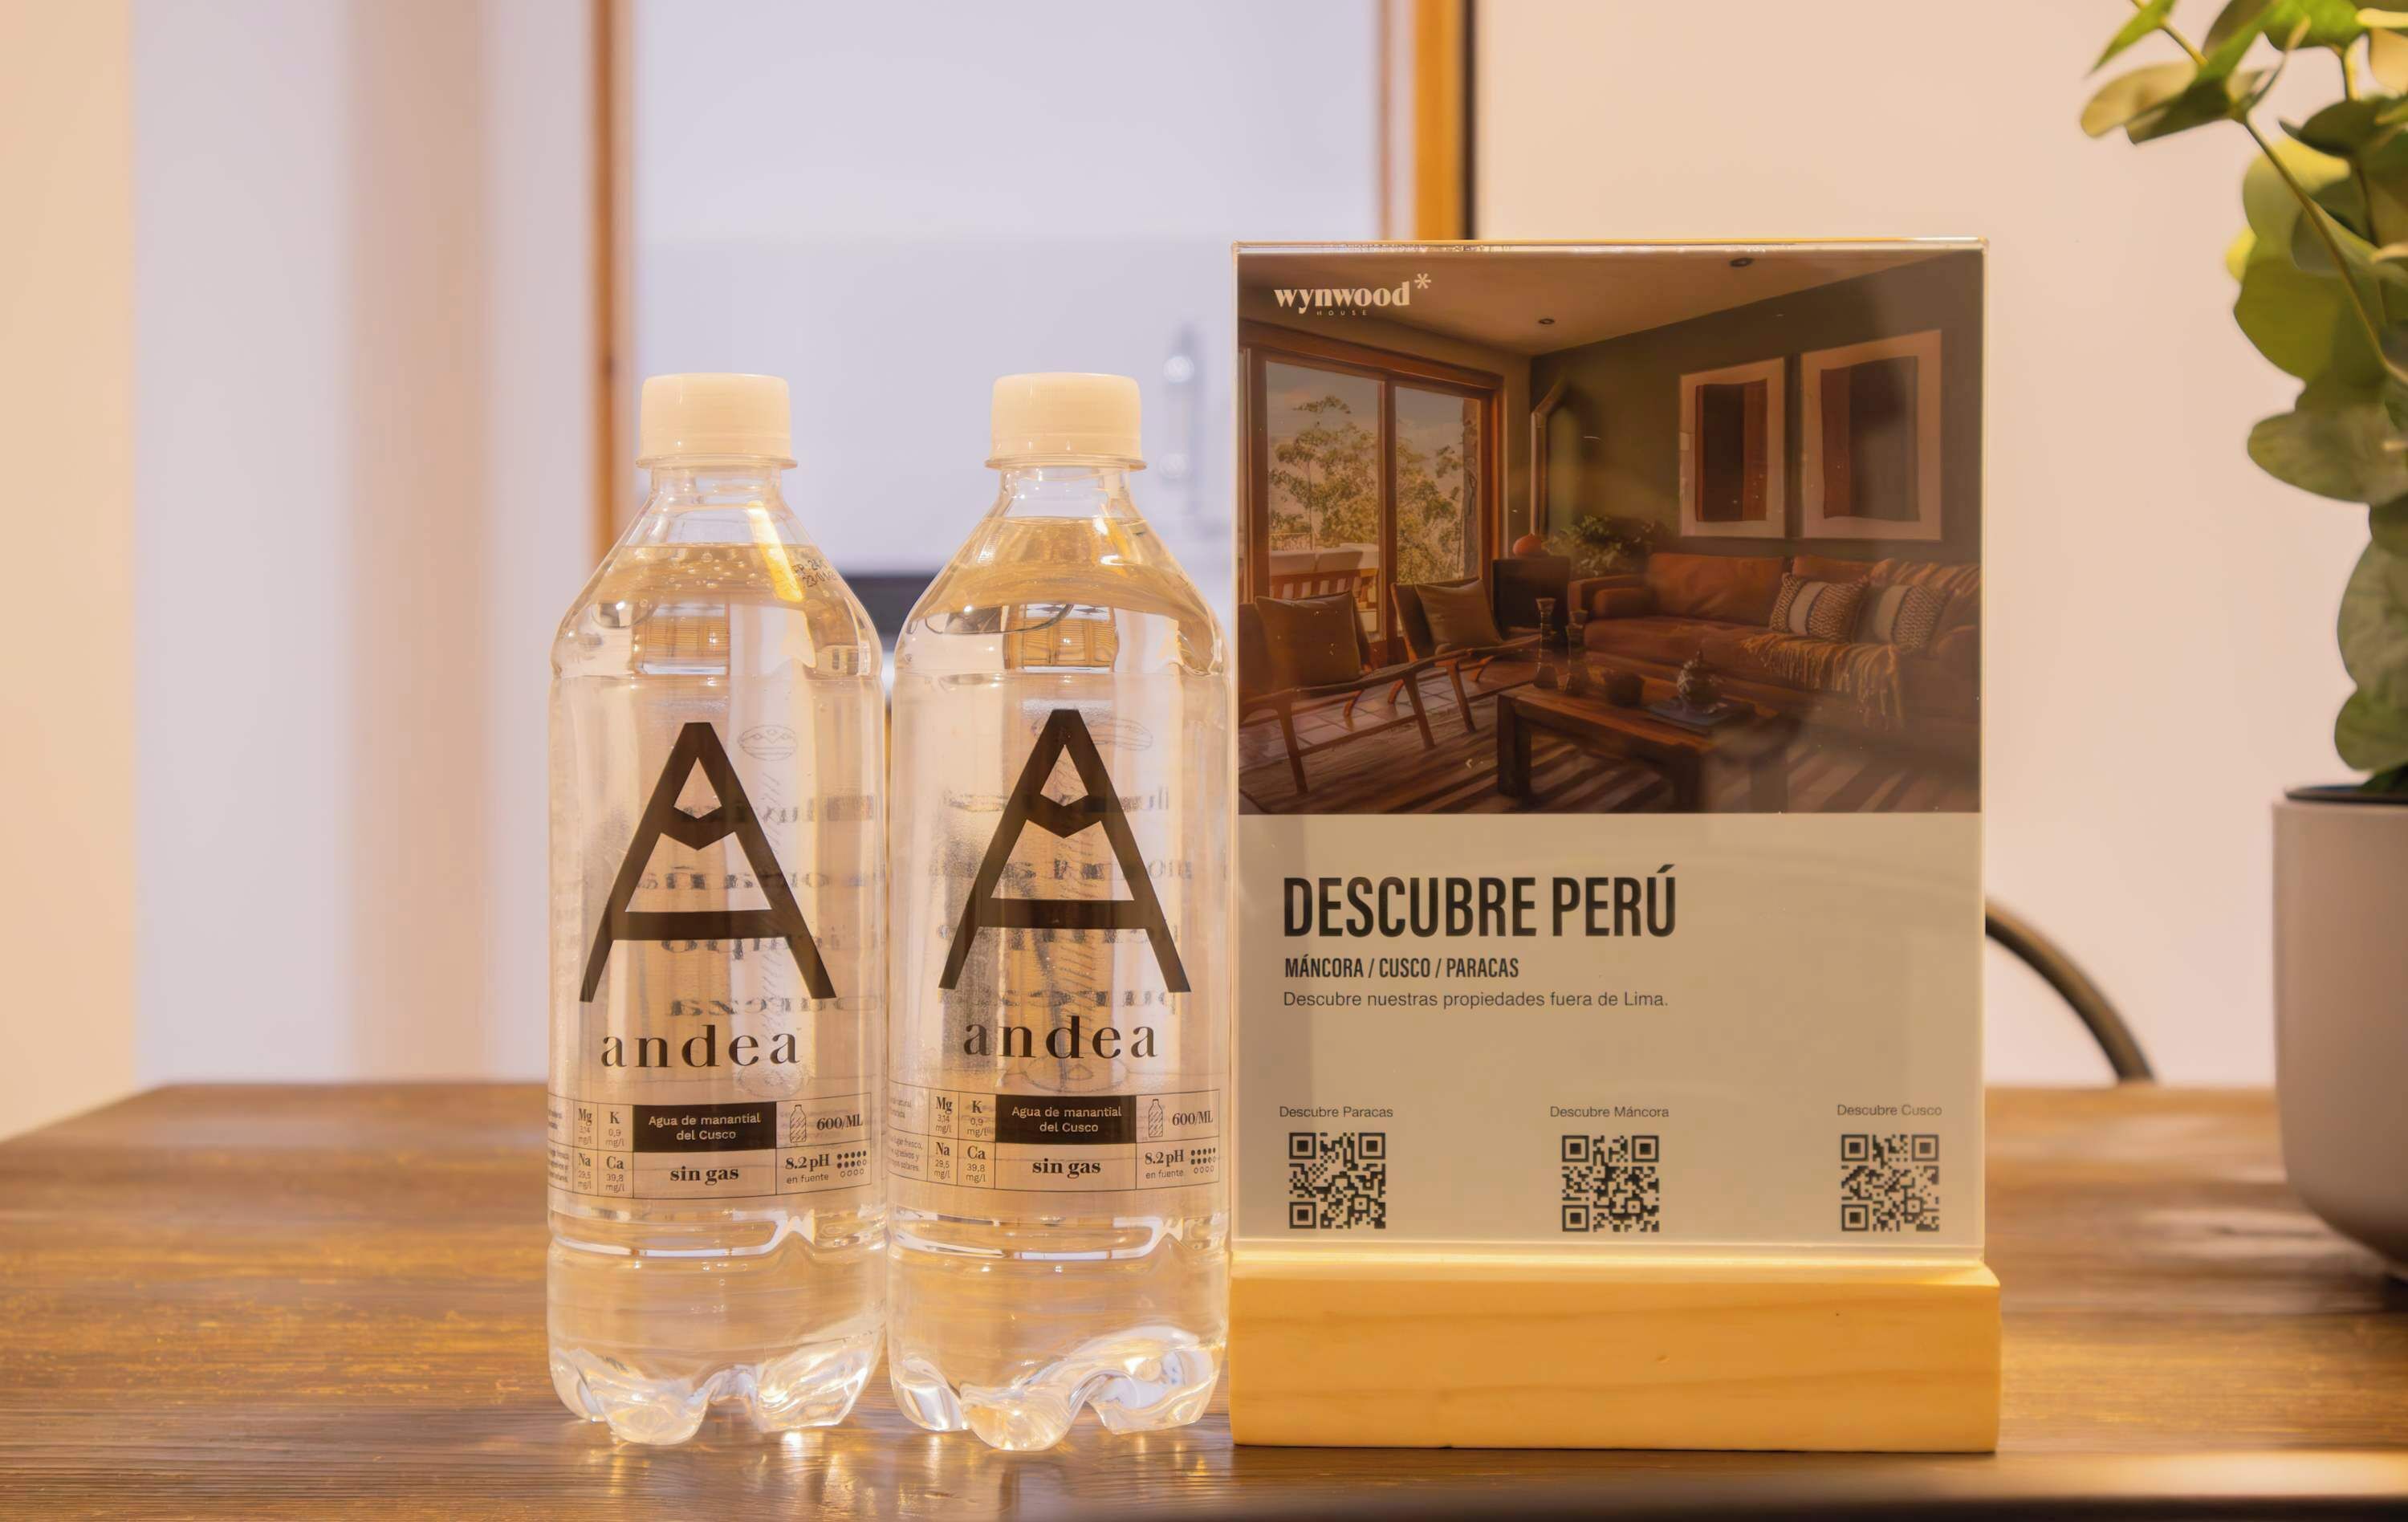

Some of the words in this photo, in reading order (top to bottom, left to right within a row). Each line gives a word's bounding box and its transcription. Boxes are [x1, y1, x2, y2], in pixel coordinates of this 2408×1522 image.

[1283, 877, 1538, 938] DESCUBRE
[1552, 864, 1677, 938] PERÚ
[1284, 954, 1365, 978] MÁNCORA
[1379, 958, 1431, 978] CUSCO
[1446, 958, 1519, 978] PARACAS
[1283, 991, 1362, 1007] Descubre
[1367, 993, 1438, 1007] nuestras
[1443, 991, 1545, 1010] propiedades
[1550, 991, 1592, 1007] fuera
[1597, 991, 1618, 1007] de
[1624, 991, 1669, 1007] Lima.
[963, 1015, 1159, 1060] andea
[601, 1024, 801, 1068] andea
[936, 1096, 953, 1115] Mg
[971, 1100, 982, 1113] K
[1011, 1106, 1040, 1119] Agua
[1044, 1106, 1060, 1117] de
[1064, 1105, 1122, 1117] manantial
[1279, 1106, 1340, 1117] Descubre
[1343, 1106, 1393, 1117] Paracas
[1550, 1106, 1610, 1117] Descubre
[1614, 1106, 1670, 1117] Máncora
[1837, 1104, 1898, 1116] Descubre
[1901, 1104, 1943, 1116] Cusco
[578, 1108, 592, 1126] Mg
[610, 1111, 620, 1124] K
[649, 1115, 678, 1128] Agua
[681, 1115, 696, 1125] de
[701, 1112, 761, 1124] manantial
[1039, 1121, 1059, 1133] del
[1062, 1121, 1099, 1133] Cusco
[677, 1129, 695, 1141] del
[699, 1129, 736, 1141] Cusco
[936, 1142, 950, 1156] Na
[967, 1146, 986, 1160] Ca
[578, 1153, 591, 1166] Na
[606, 1156, 624, 1170] Ca
[785, 1156, 807, 1170] 8.2
[809, 1154, 829, 1172] pH
[1145, 1152, 1164, 1165] 8.2
[1165, 1149, 1184, 1167] pH
[966, 1163, 985, 1173] 39,8
[1032, 1158, 1063, 1174] sin
[1068, 1162, 1101, 1178] gas
[1158, 1170, 1184, 1178] fuente
[670, 1166, 701, 1182] sin
[706, 1167, 739, 1186] gas
[787, 1176, 798, 1184] en
[801, 1174, 829, 1183] fuente
[966, 1173, 986, 1183] mg/l
